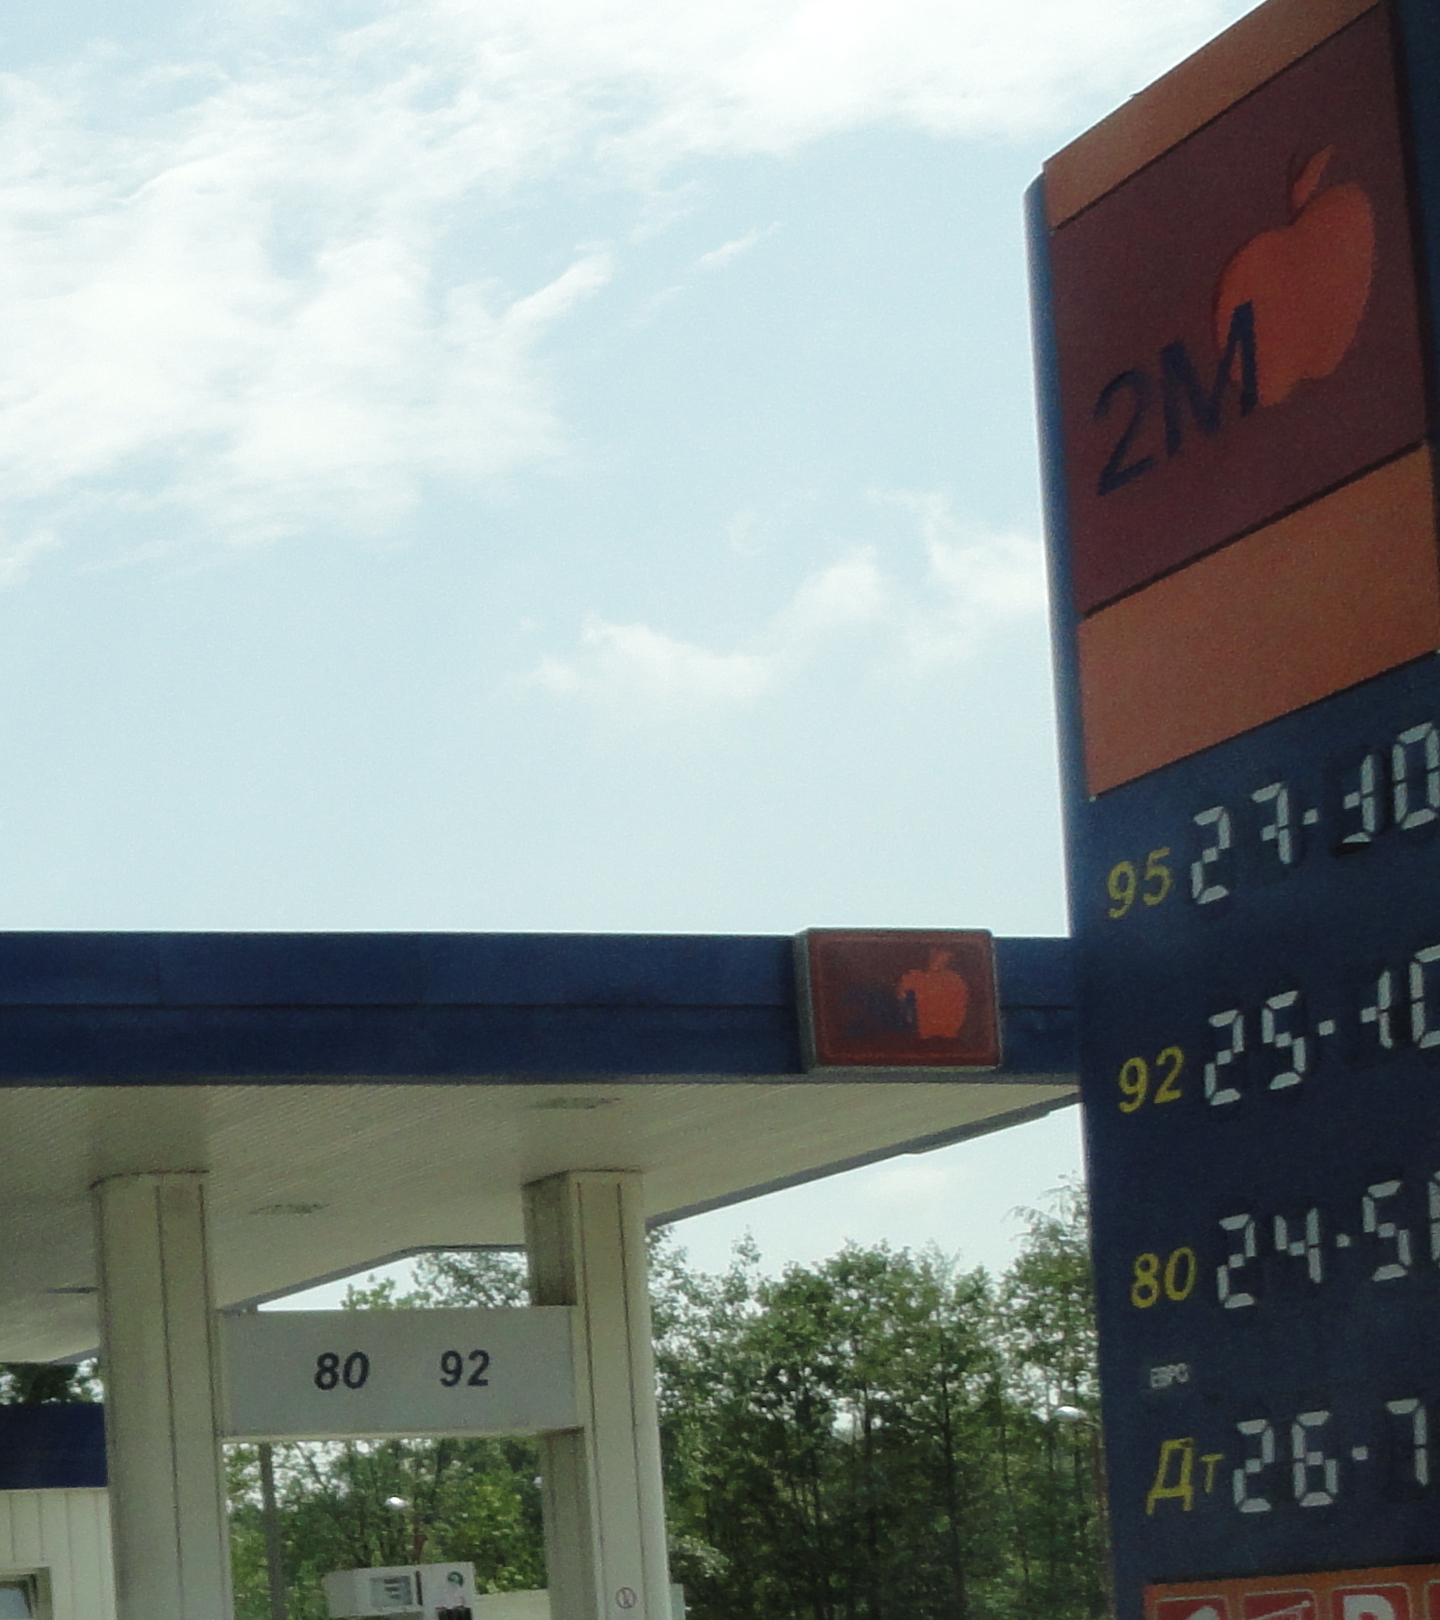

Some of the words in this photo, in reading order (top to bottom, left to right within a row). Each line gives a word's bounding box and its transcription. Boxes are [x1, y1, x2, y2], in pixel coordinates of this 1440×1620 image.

[1091, 298, 1259, 498] 2M
[1107, 846, 1173, 918] 95
[1118, 1045, 1185, 1114] 92
[1131, 1246, 1197, 1308] 80
[313, 1351, 370, 1390] 80
[439, 1349, 490, 1387] 92
